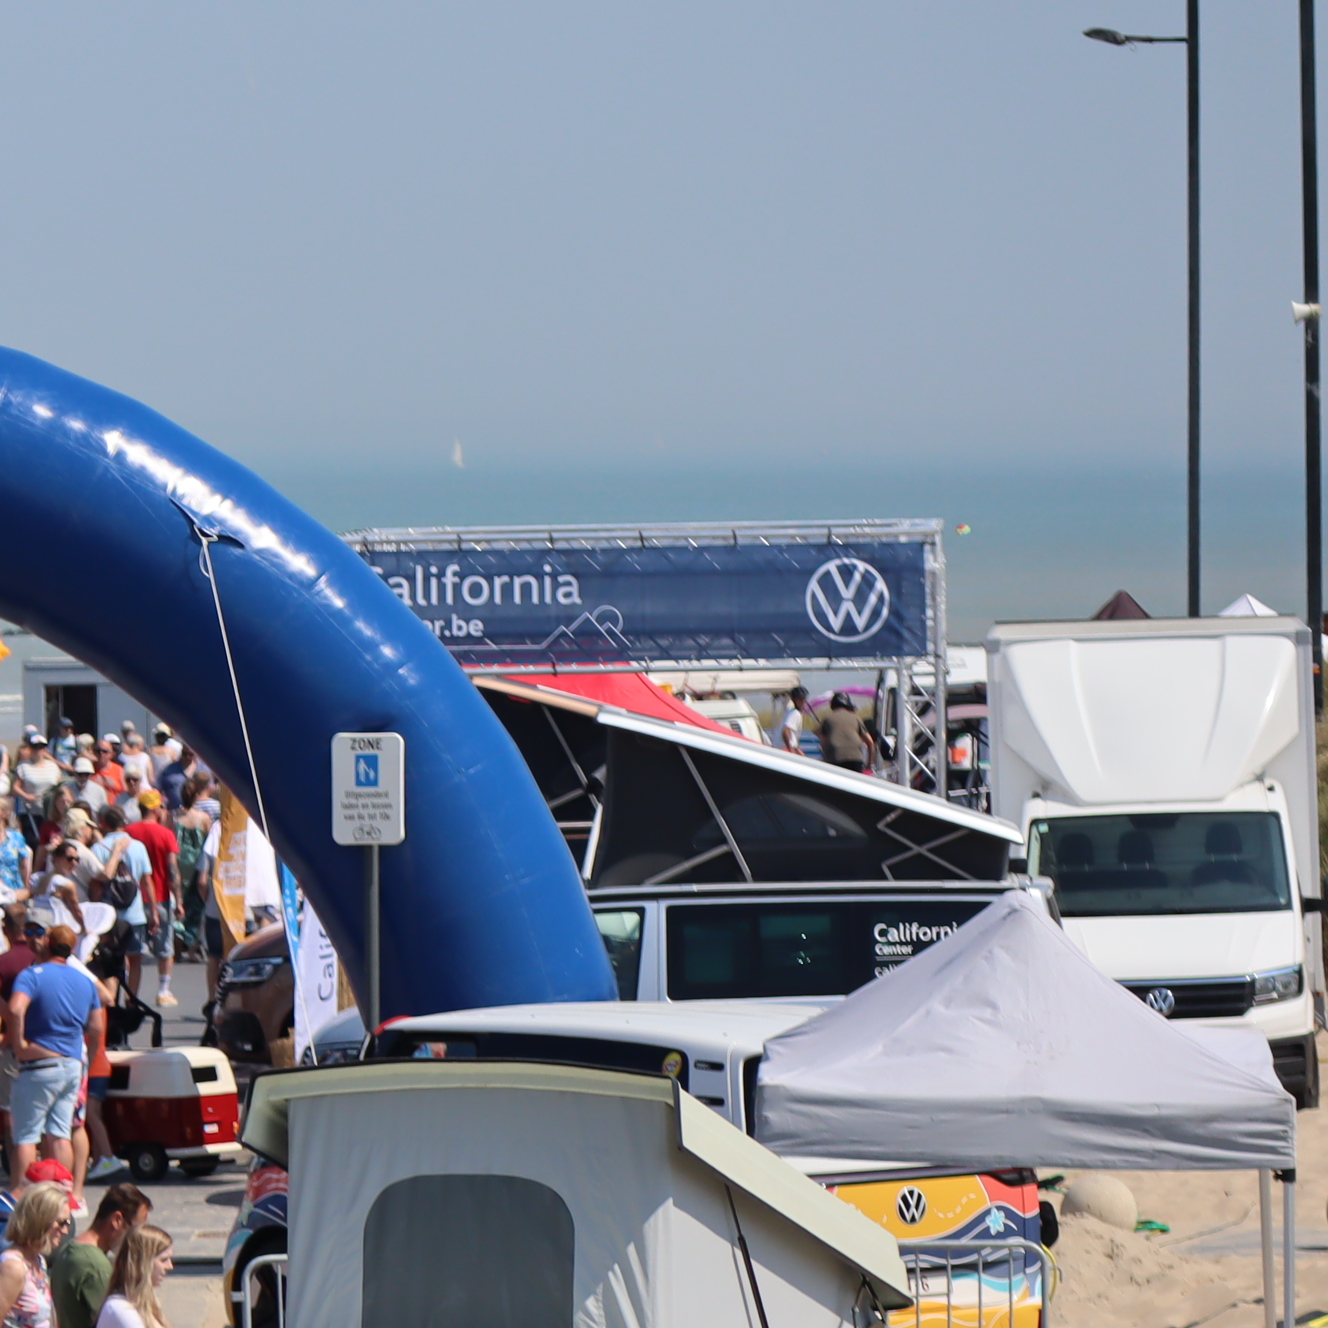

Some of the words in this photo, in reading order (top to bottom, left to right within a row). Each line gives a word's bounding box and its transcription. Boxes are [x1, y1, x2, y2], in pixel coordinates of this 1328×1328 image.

[371, 564, 582, 607] alifornia
[806, 557, 890, 643] VW
[350, 738, 383, 751] ZONE
[875, 943, 913, 955] Center
[896, 1186, 928, 1226] VW
